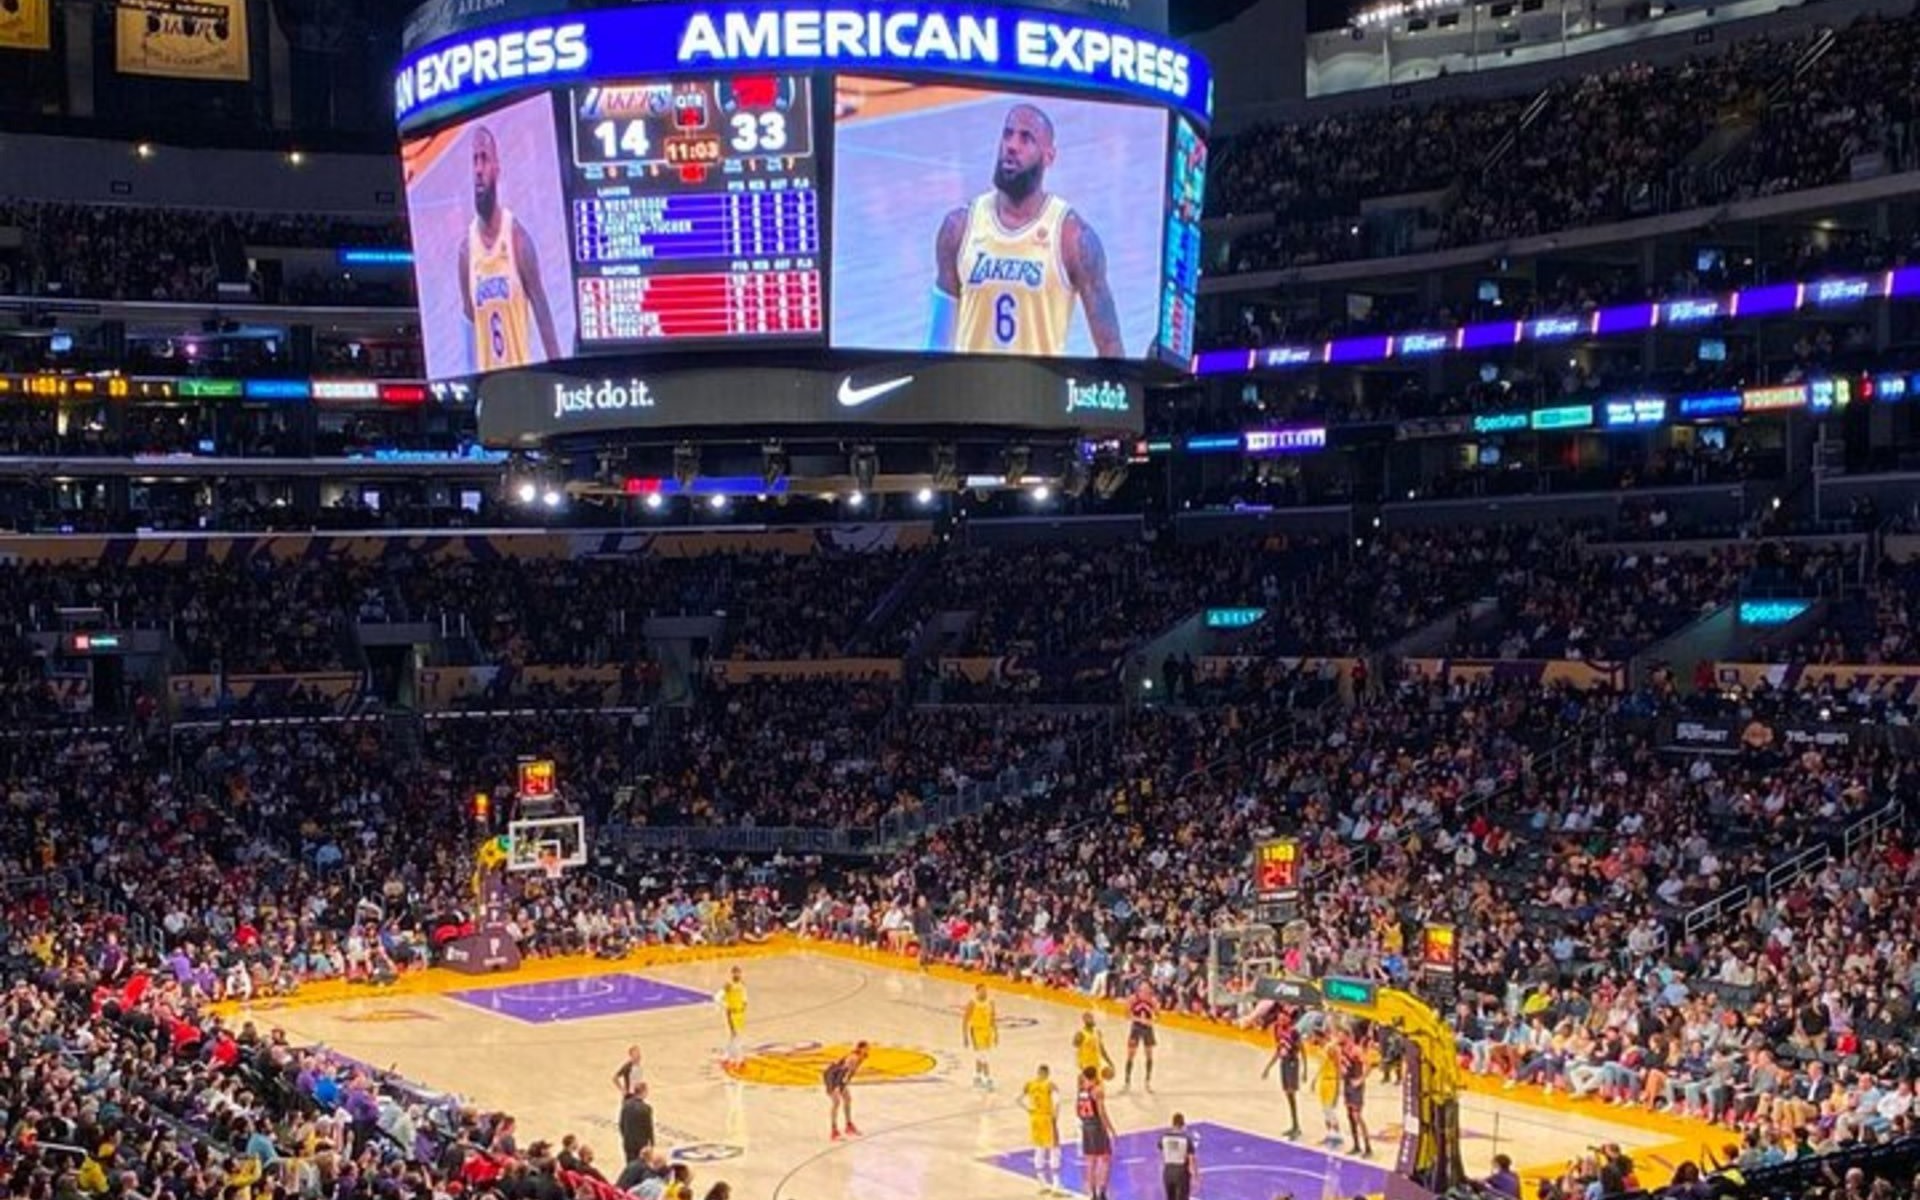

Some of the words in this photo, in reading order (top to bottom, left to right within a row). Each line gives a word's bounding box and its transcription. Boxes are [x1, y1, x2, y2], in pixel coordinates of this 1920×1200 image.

[417, 24, 587, 101] EXPRESS
[678, 12, 998, 61] AMERICAN
[1017, 21, 1190, 97] EXPRESS
[594, 119, 649, 157] 14
[730, 112, 787, 151] 33
[667, 142, 719, 161] 11:03
[968, 252, 1044, 287] LAKERS
[490, 311, 504, 357] 6
[996, 293, 1015, 343] 6
[554, 383, 595, 418] Just
[596, 380, 628, 408] do
[629, 378, 654, 407] it.
[1066, 378, 1099, 413] Just
[1263, 862, 1292, 888] 24
